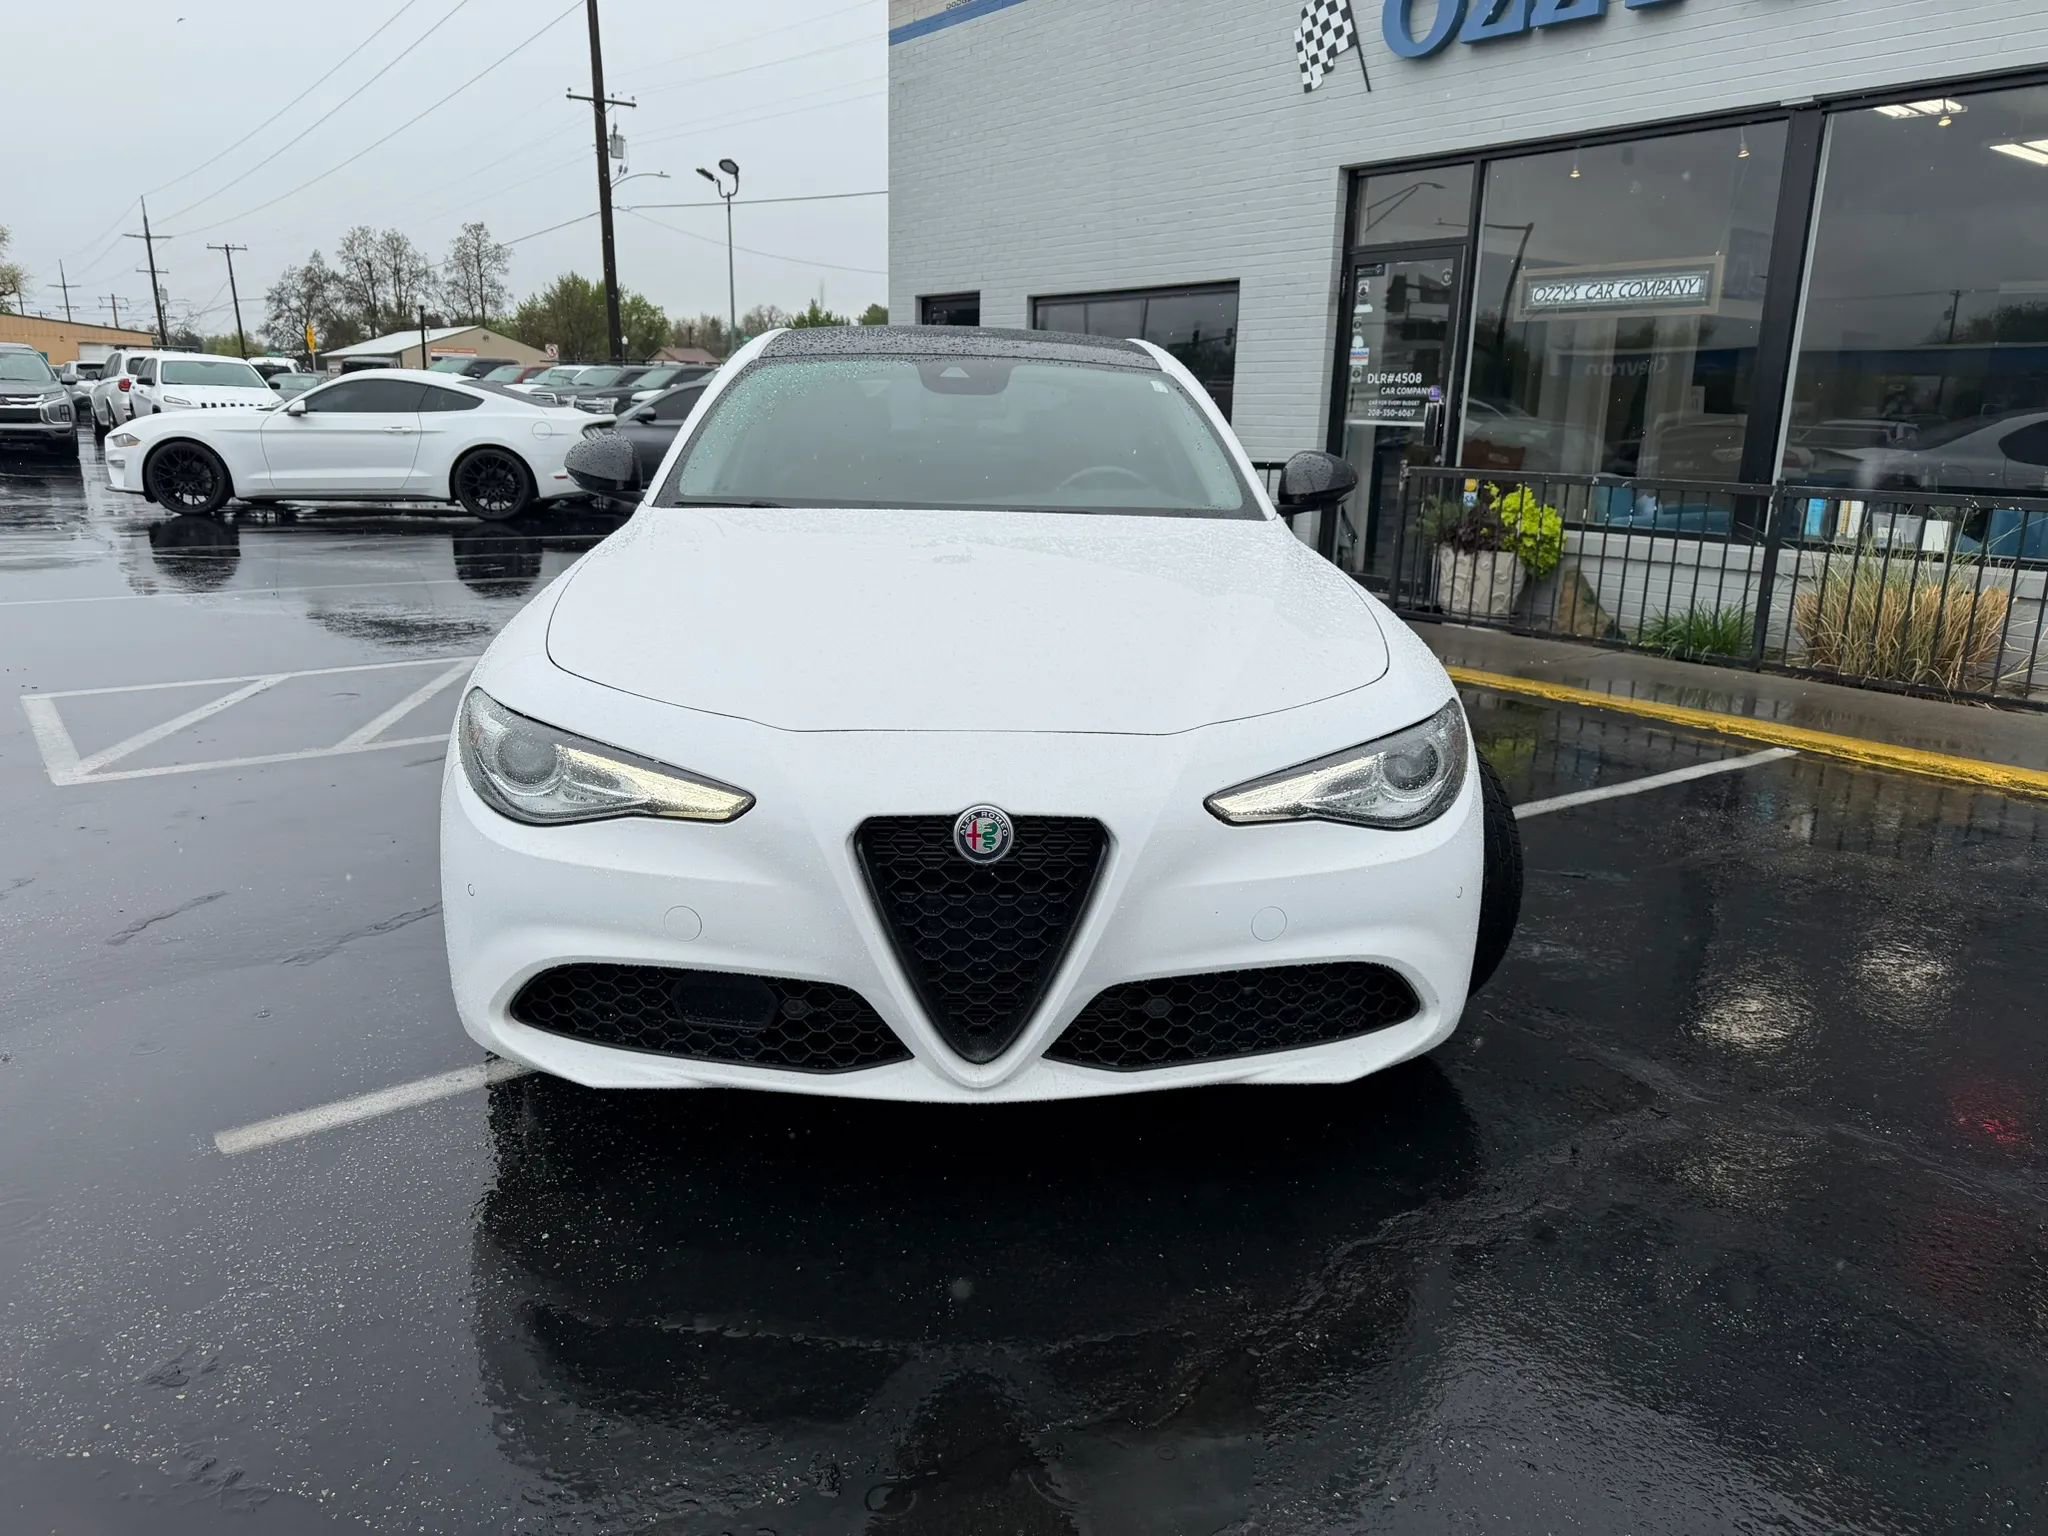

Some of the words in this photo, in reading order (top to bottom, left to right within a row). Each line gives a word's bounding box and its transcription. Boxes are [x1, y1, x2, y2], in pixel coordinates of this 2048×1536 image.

[1533, 284, 1582, 302] OZZY'S
[1585, 283, 1615, 300] CAR
[1618, 278, 1700, 299] COMPANY
[1367, 372, 1423, 385] DLR#4508
[1381, 387, 1396, 395] CAR
[960, 814, 978, 836] ALFA
[981, 811, 1009, 837] ROMEO
